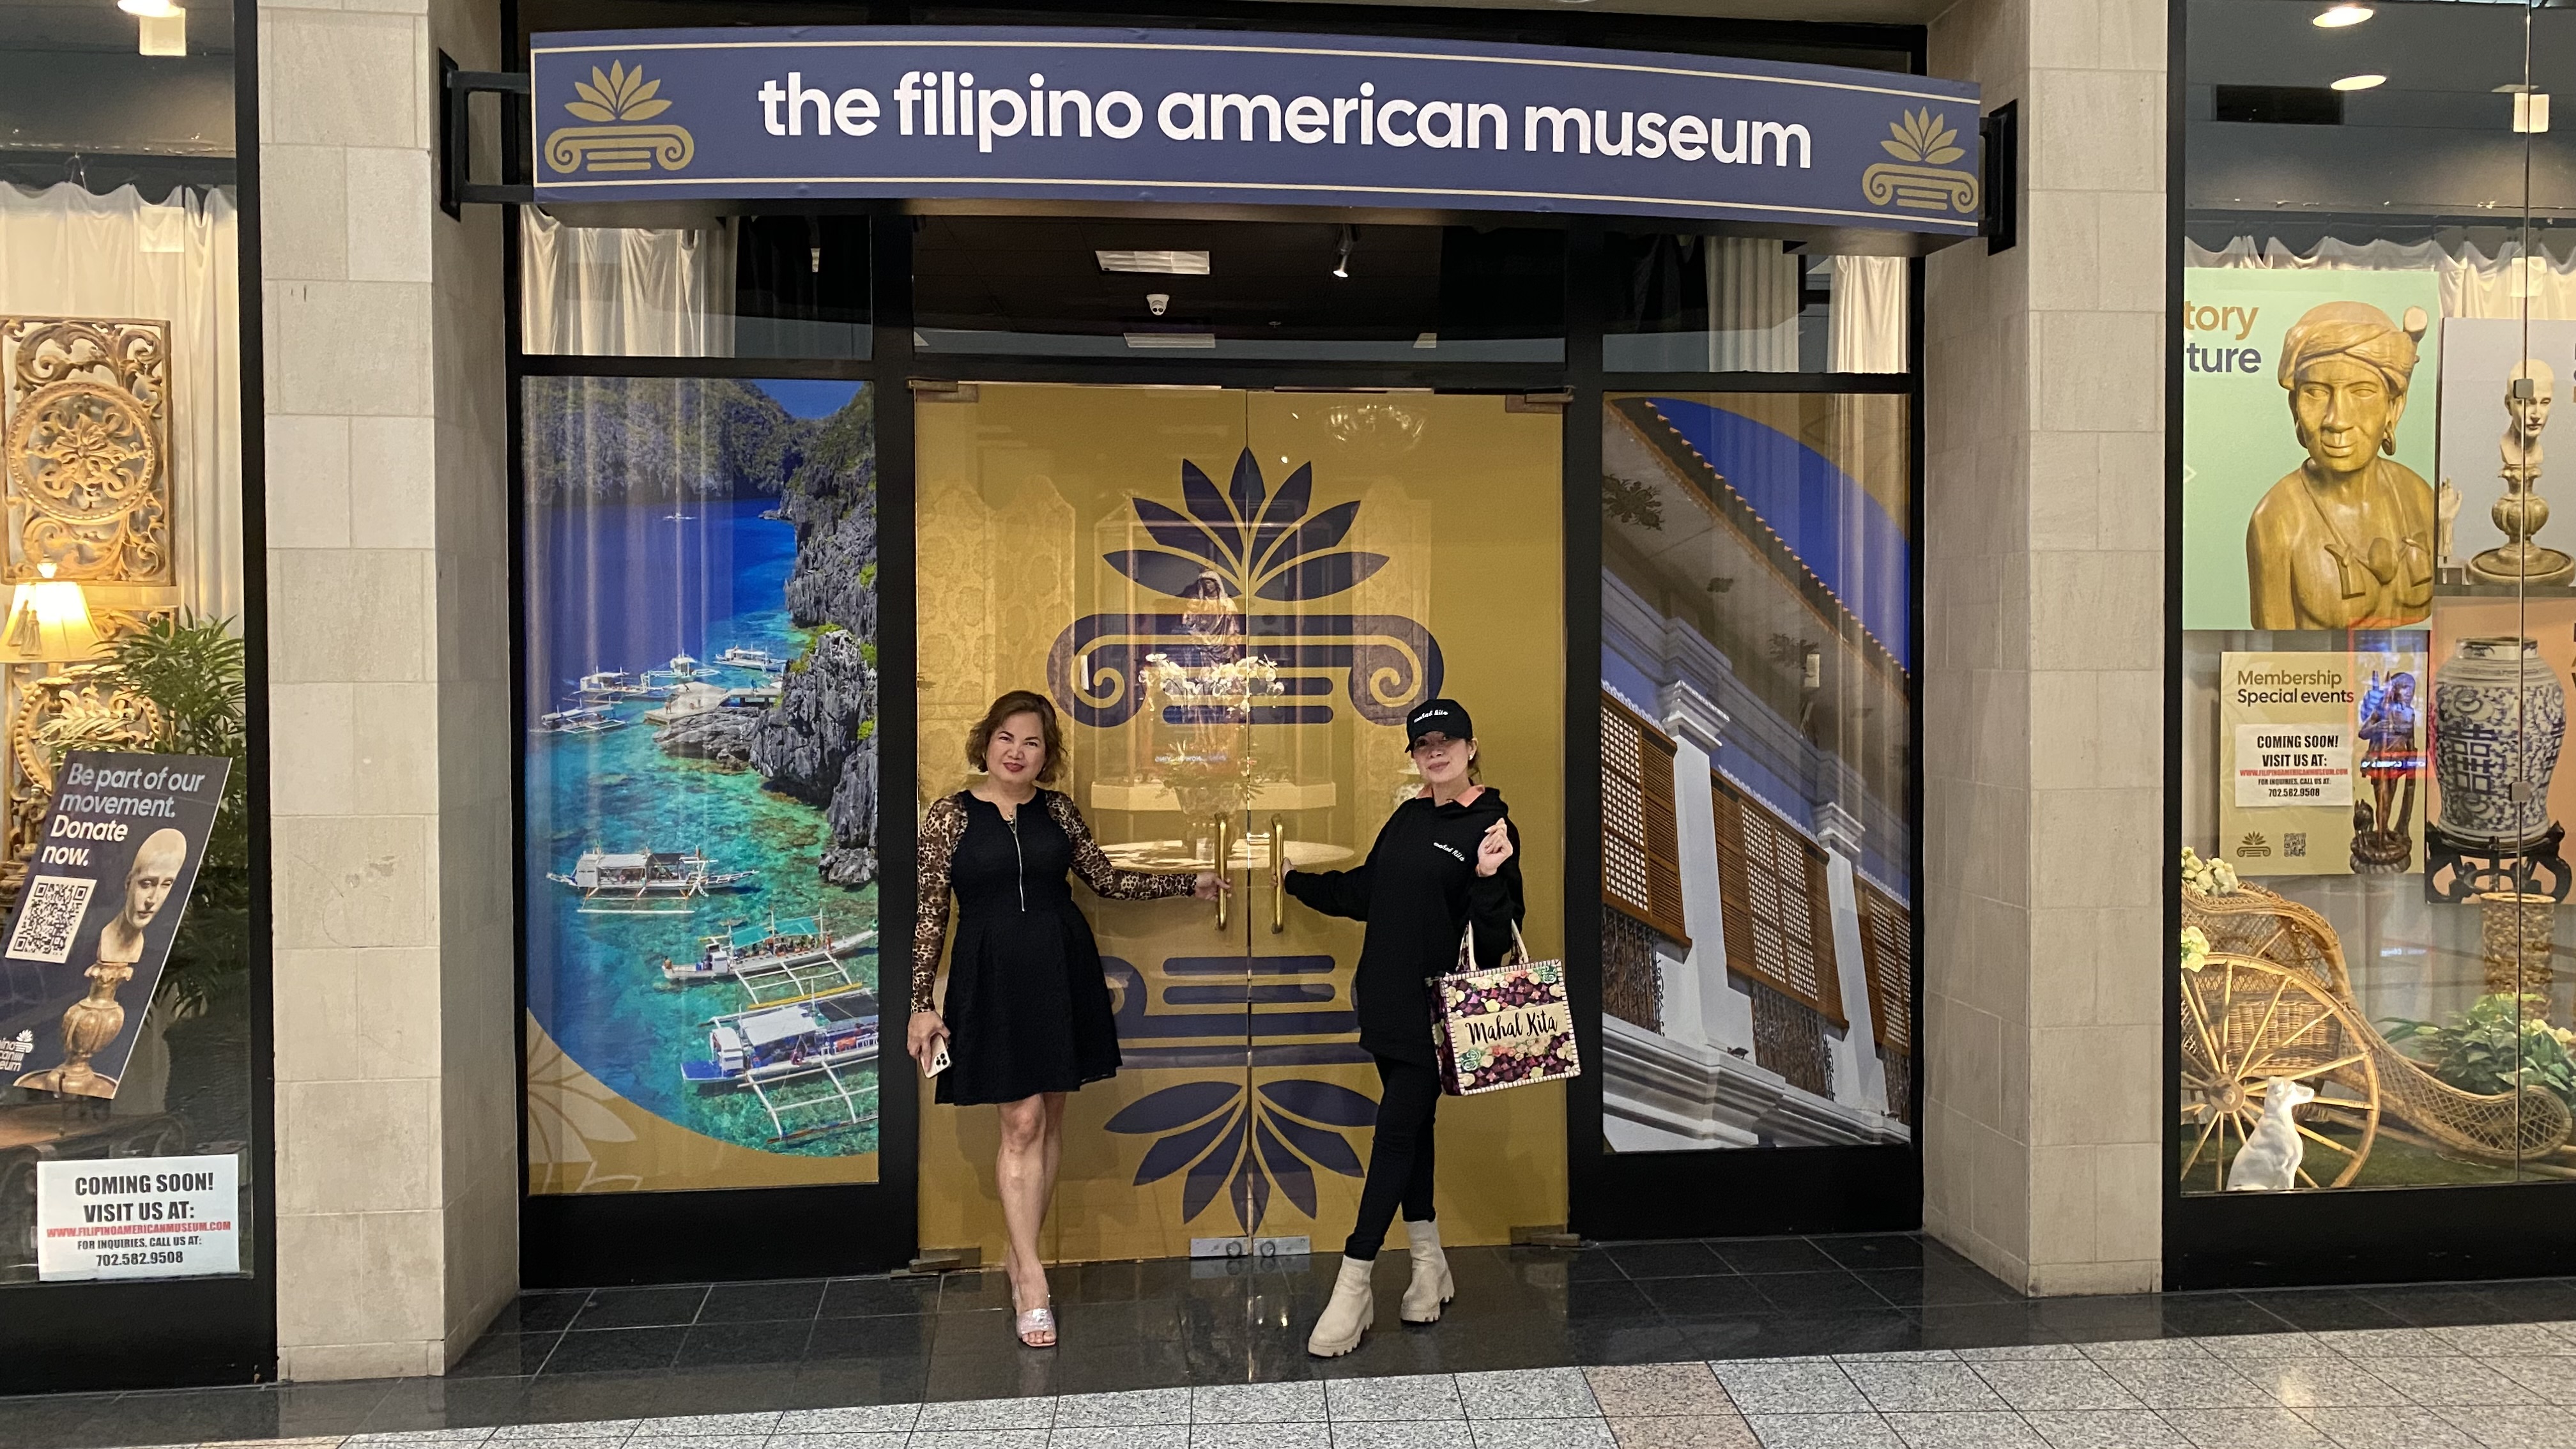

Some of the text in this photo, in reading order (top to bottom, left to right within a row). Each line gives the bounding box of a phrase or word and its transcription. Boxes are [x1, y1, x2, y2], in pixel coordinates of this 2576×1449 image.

[758, 70, 1811, 169] the filipino american museum
[2184, 300, 2260, 341] tory
[2186, 342, 2262, 374] ture
[2237, 670, 2342, 689] Membership
[2237, 688, 2354, 707] Special events
[2257, 735, 2339, 748] COMING SOON!
[2262, 754, 2327, 767] VISIT US AT:
[67, 763, 206, 792] Be part of our
[2269, 788, 2320, 797] 702.582.9508
[59, 793, 176, 818] movement.
[50, 815, 128, 842] Donate
[40, 845, 90, 867] now.
[1465, 1009, 1558, 1045] Mahal Kita
[75, 1172, 214, 1196] COMING SOON!
[83, 1200, 195, 1223] VISIT US AT:
[46, 1221, 231, 1238] WWW.FILIPINOAMERICANMUSEUM.COM
[77, 1236, 203, 1250] FOR INQUIRIES, CALL US AT:
[96, 1250, 183, 1267] 702.582.9508
